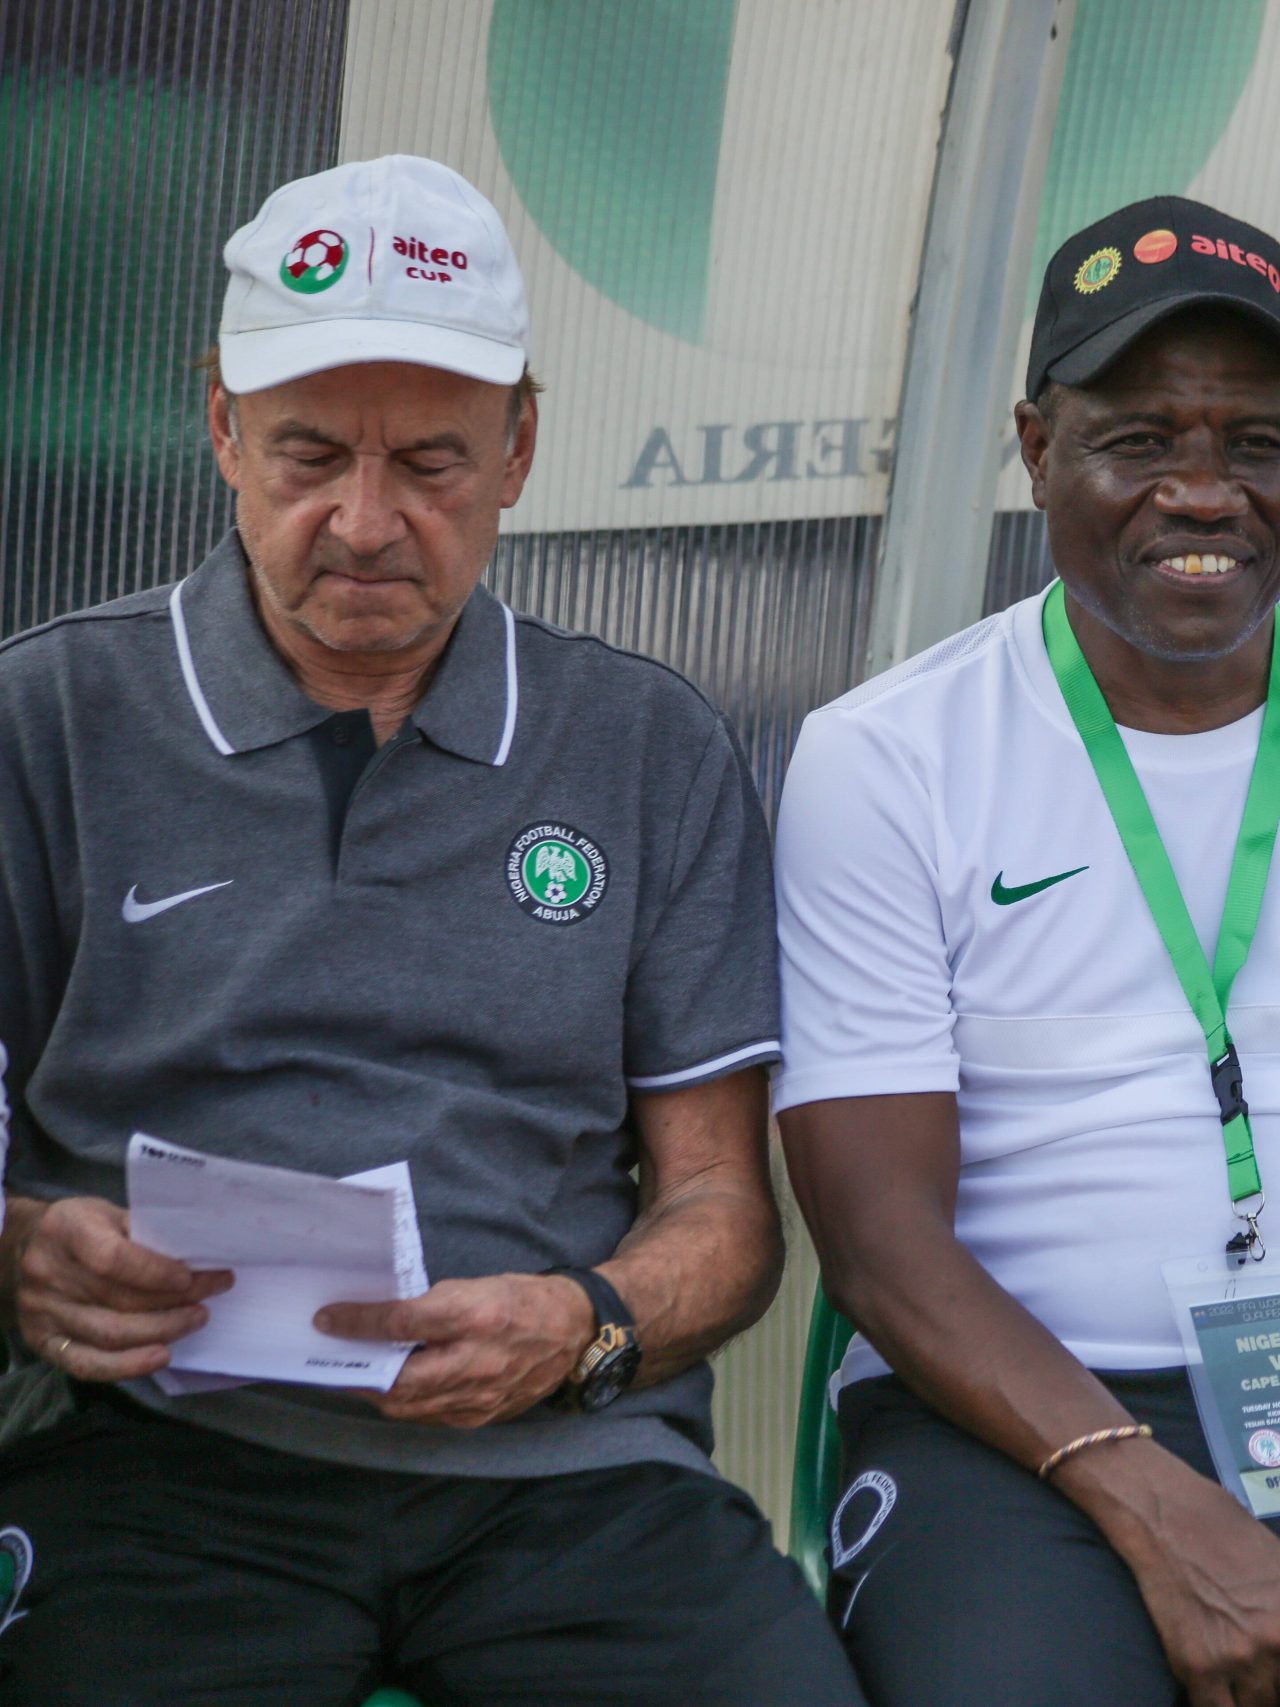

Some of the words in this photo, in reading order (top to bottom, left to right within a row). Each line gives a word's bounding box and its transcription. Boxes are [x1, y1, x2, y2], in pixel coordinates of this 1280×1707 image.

[392, 235, 467, 270] aiteo
[1191, 234, 1280, 293] aiteo
[406, 266, 453, 283] CUP
[515, 825, 575, 852] FOOTBALL
[508, 851, 530, 903] NIGERIA
[575, 838, 606, 908] FEDERATION
[532, 906, 581, 920] ABUJA
[1241, 1375, 1280, 1391] CAPE
